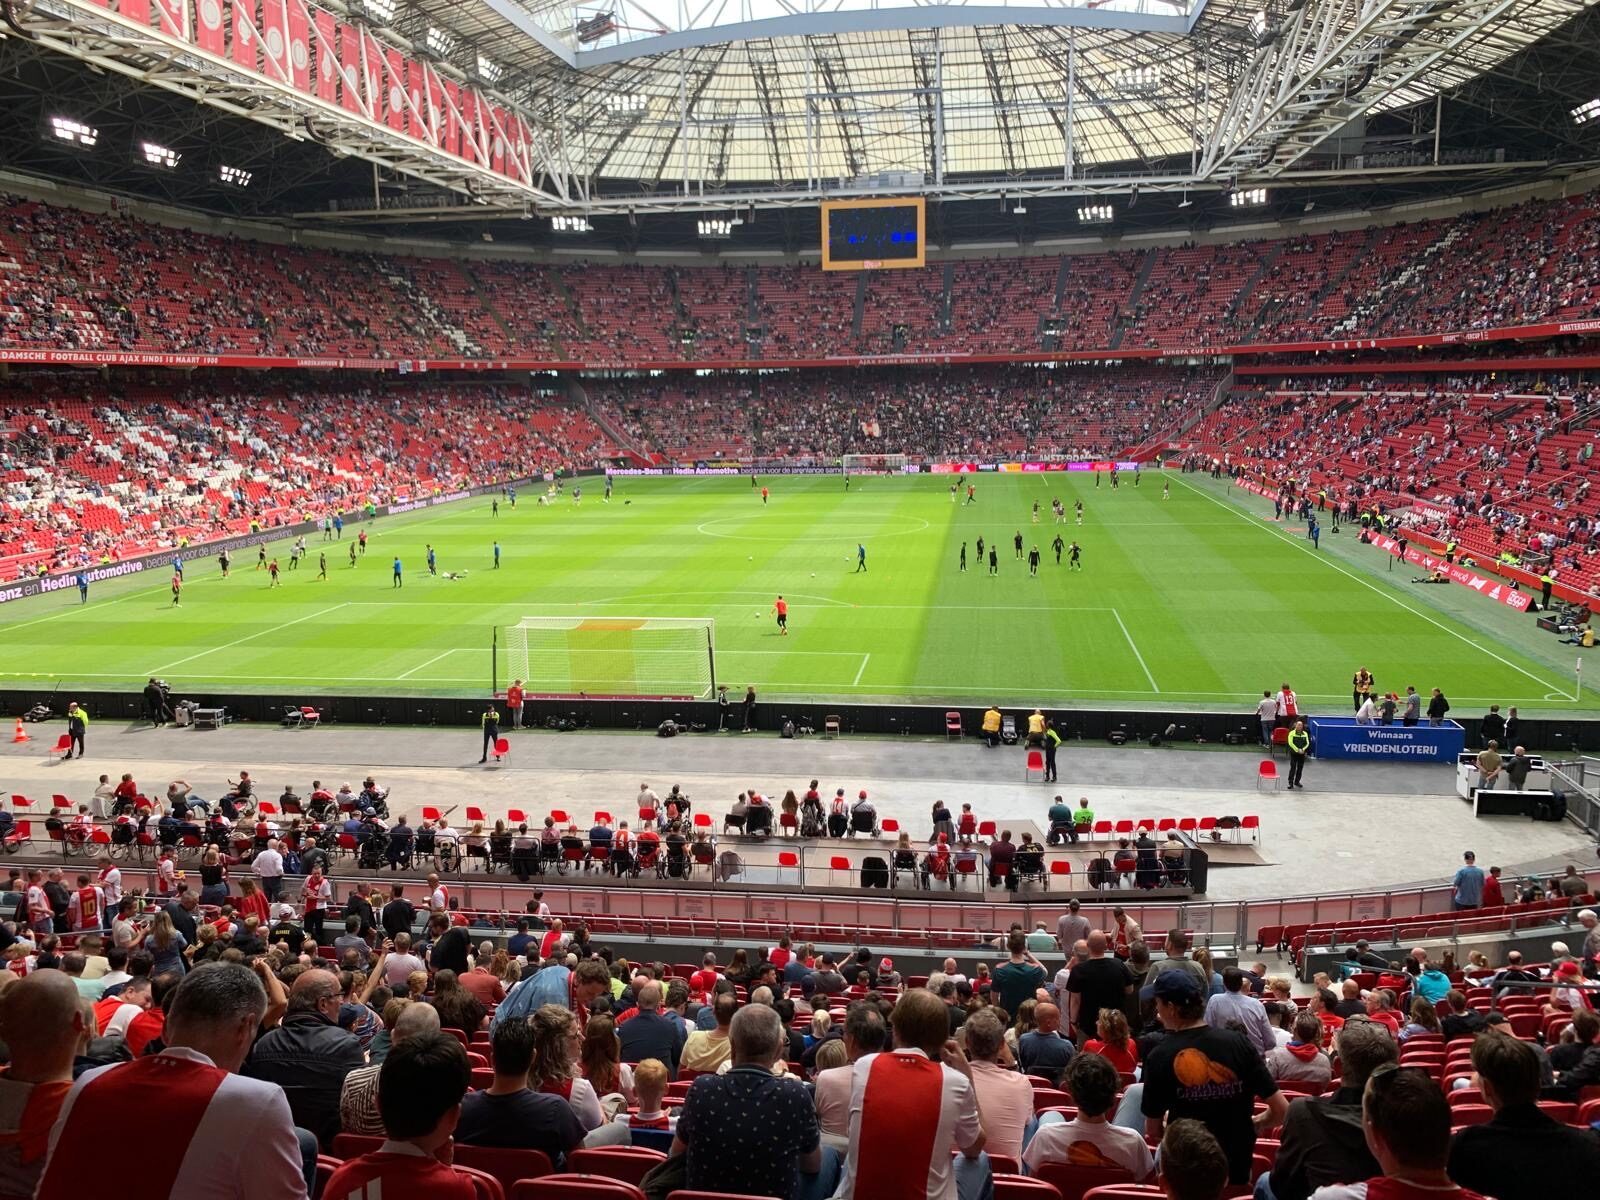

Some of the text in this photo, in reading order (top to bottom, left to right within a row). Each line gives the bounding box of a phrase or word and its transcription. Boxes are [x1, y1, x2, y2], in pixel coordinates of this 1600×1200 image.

[1, 351, 47, 361] DAMSCHE
[50, 352, 94, 361] FOOTBALL
[96, 354, 117, 362] CLUB
[119, 355, 140, 364] AJAX
[142, 355, 163, 363] SINDS
[176, 356, 201, 364] MAART
[605, 468, 663, 476] Mercedes-Benz
[24, 584, 40, 596] en
[40, 575, 78, 592] Hedin
[198, 546, 209, 557] de
[1368, 730, 1414, 739] Winnaars
[1343, 743, 1438, 755] VRIENDENLOTERIJ
[83, 899, 96, 916] 10
